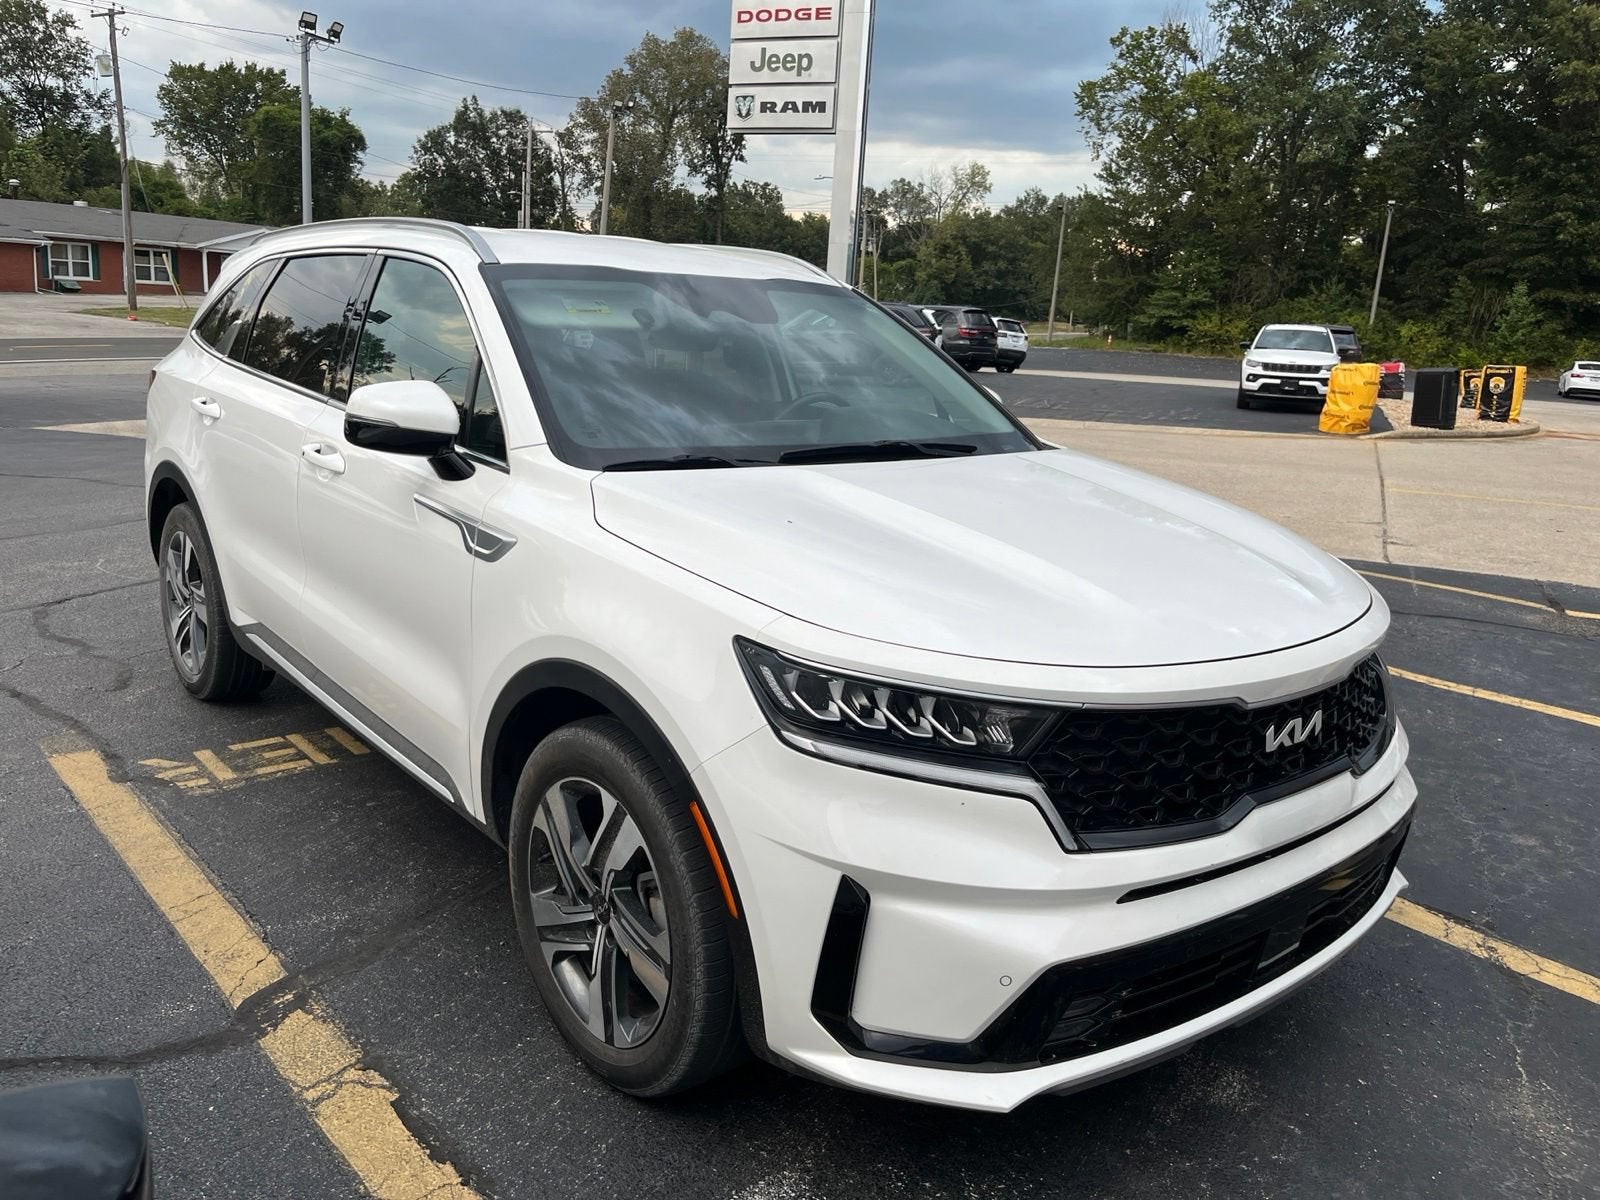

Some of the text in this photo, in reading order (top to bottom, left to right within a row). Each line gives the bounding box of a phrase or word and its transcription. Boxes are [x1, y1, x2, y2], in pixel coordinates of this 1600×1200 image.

[737, 7, 832, 23] DODGE
[750, 47, 813, 77] Jeep
[759, 101, 827, 113] RAM
[1265, 709, 1322, 752] KIA
